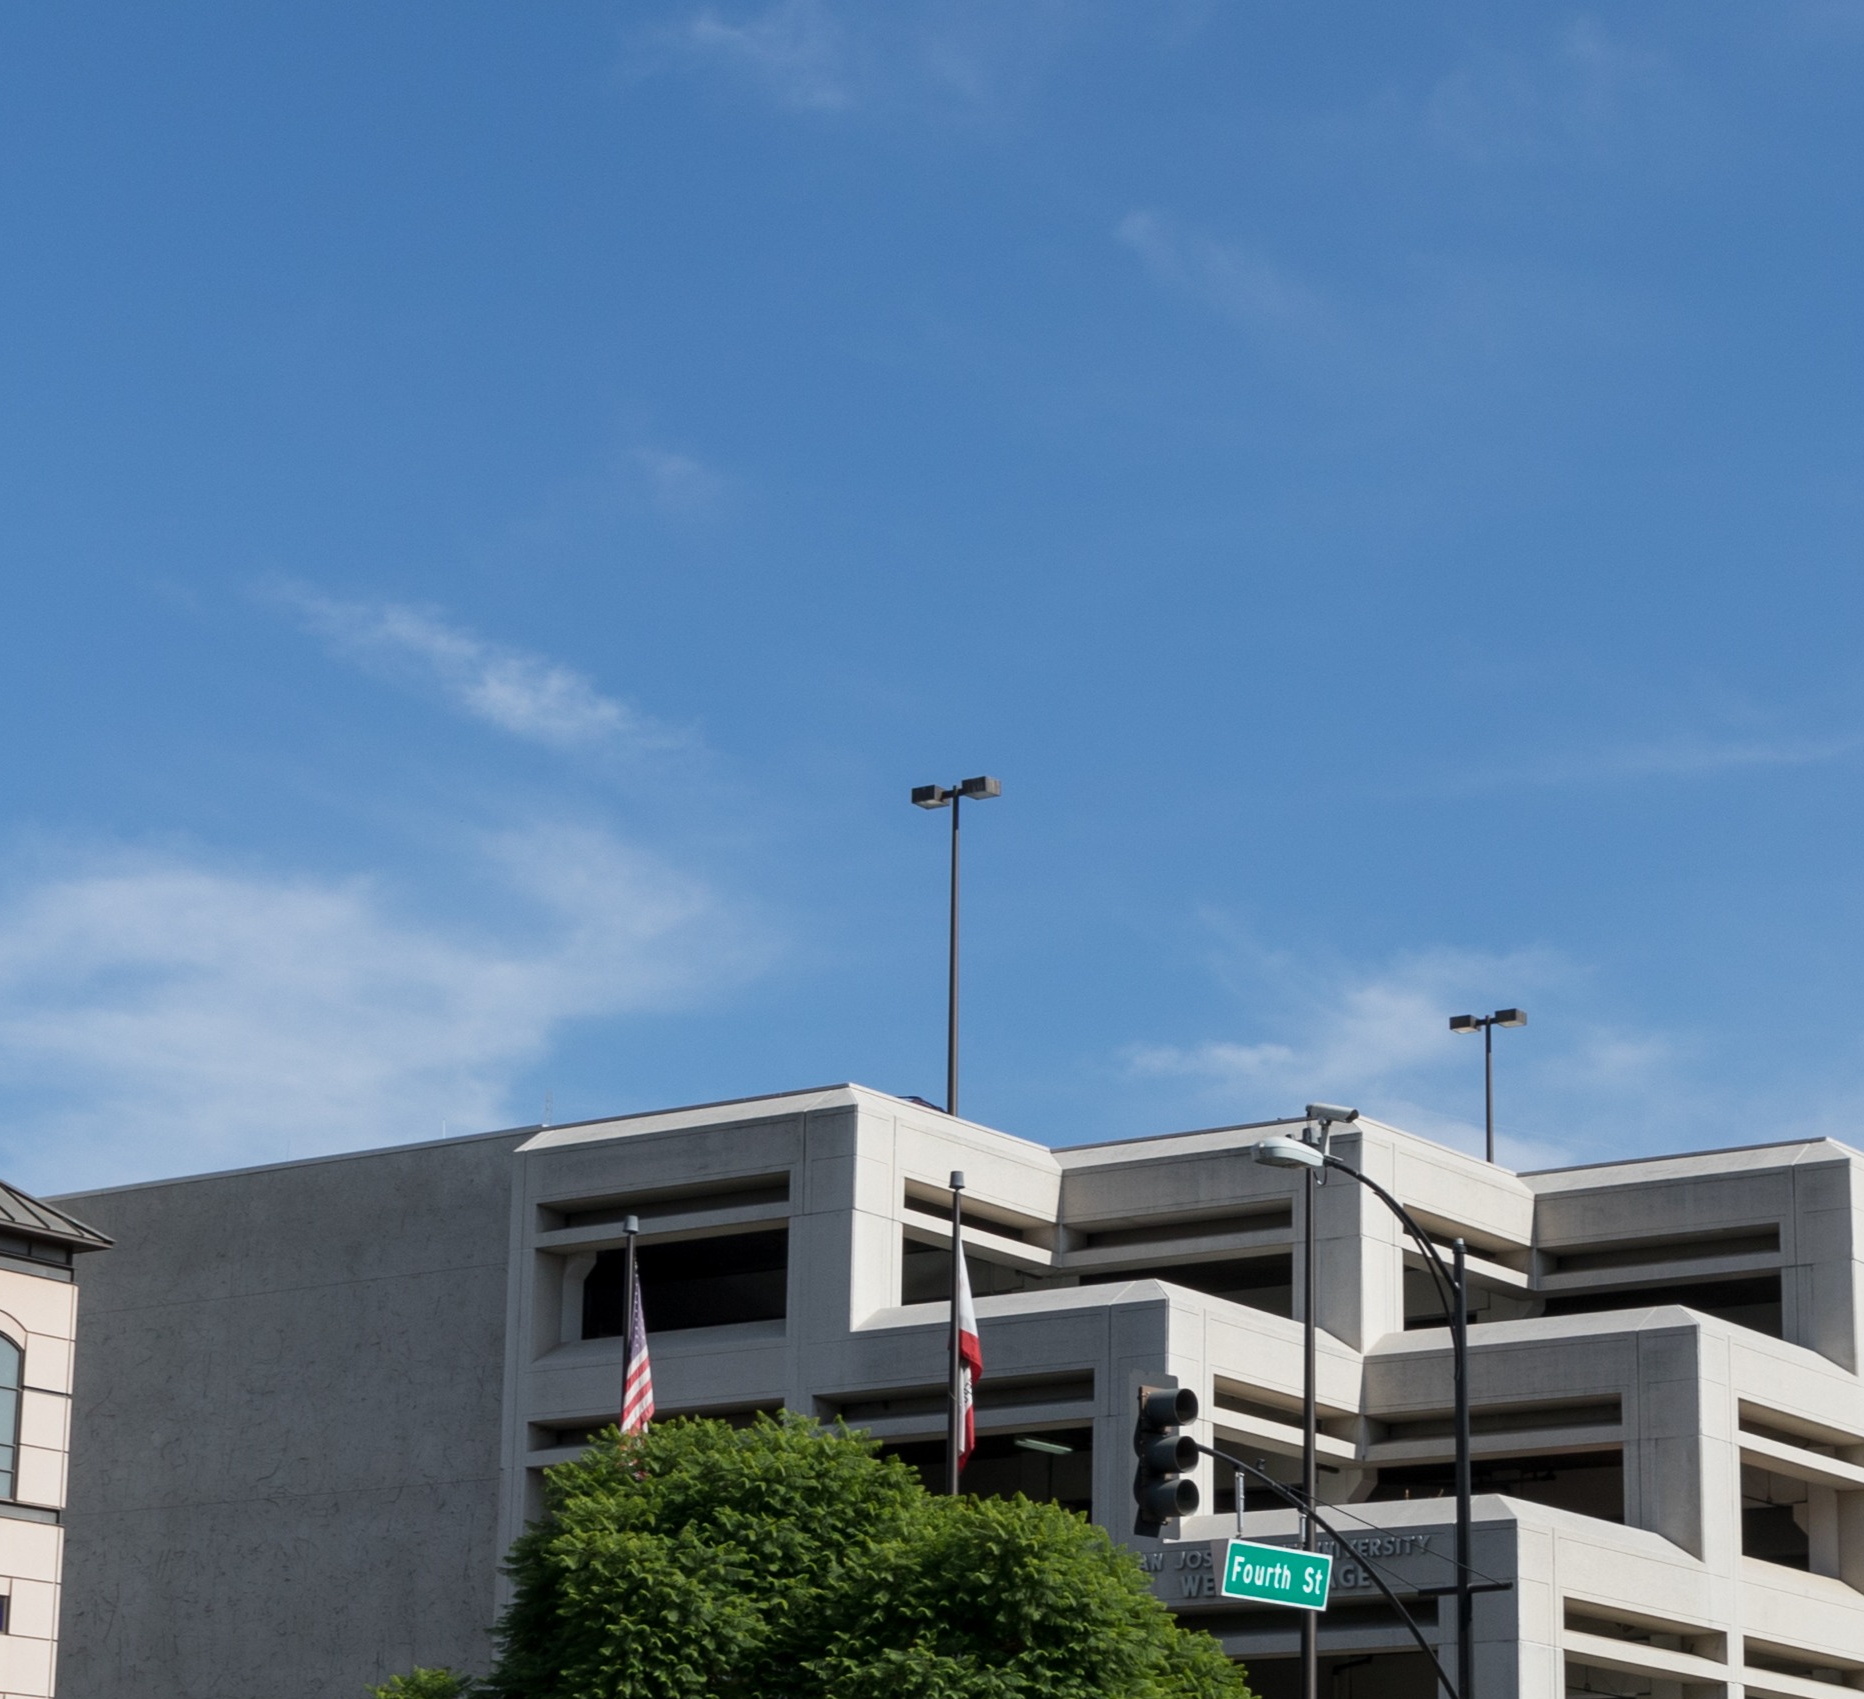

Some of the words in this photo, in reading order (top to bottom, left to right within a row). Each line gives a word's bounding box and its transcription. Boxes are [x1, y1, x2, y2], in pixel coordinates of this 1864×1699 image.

[1139, 1552, 1164, 1571] AN
[1175, 1551, 1214, 1569] JOS
[1180, 1575, 1217, 1597] WE
[1231, 1555, 1292, 1590] Fourth
[1302, 1566, 1324, 1595] St
